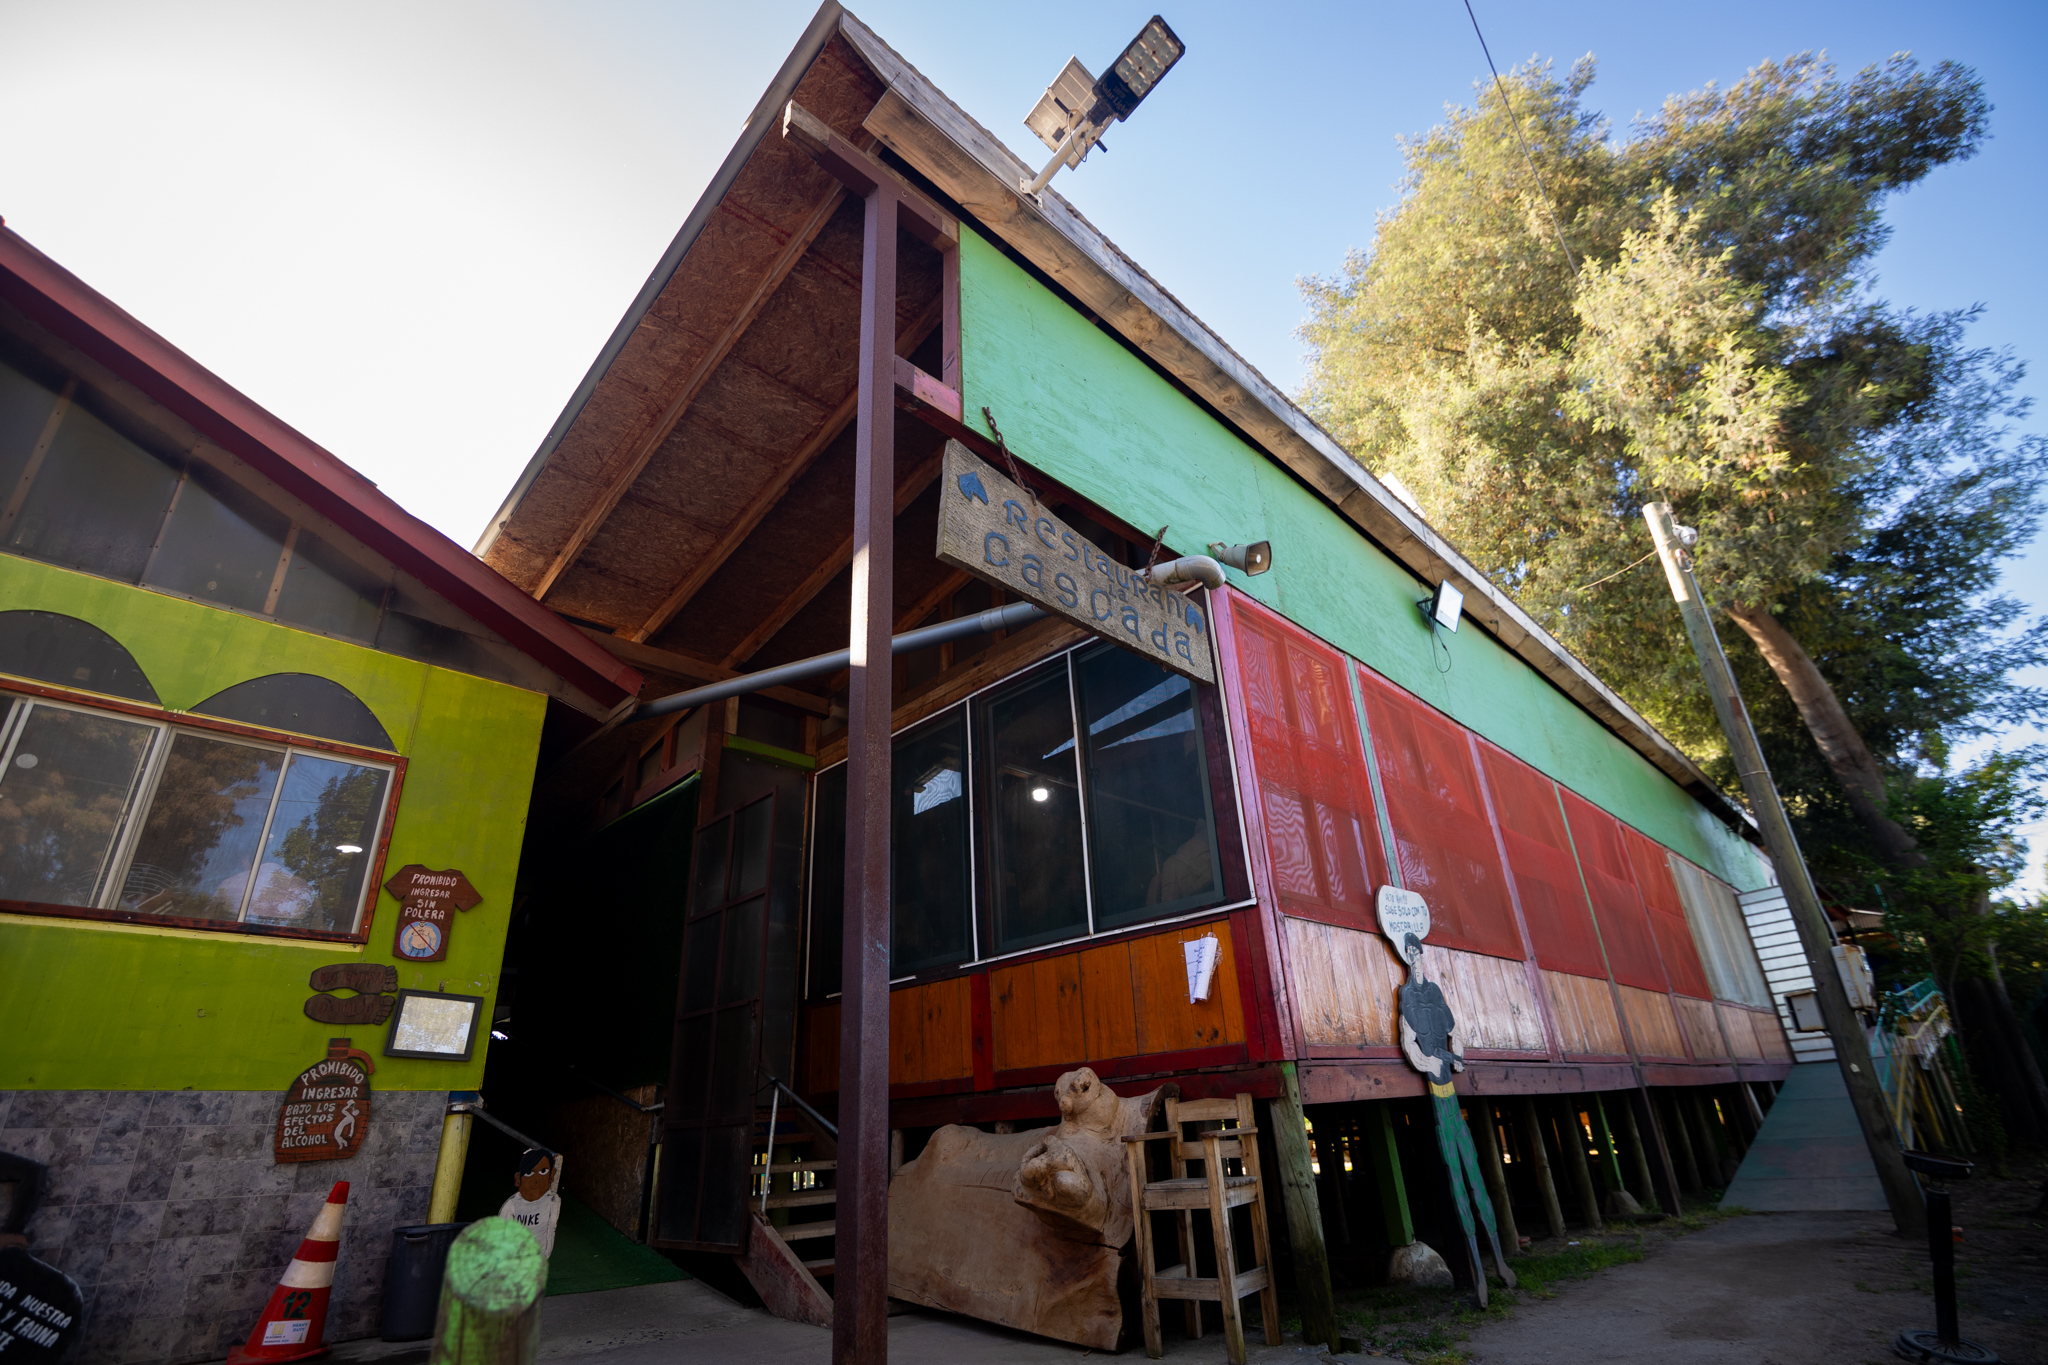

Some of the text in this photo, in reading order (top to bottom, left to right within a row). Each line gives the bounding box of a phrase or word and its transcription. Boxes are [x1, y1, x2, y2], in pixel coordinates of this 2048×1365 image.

[411, 873, 458, 887] PROHIBIDO
[410, 887, 451, 899] INGRESAR
[417, 898, 437, 909] SIN
[404, 906, 446, 920] POLERA
[301, 1061, 365, 1086] PROHIBIDO
[302, 1086, 359, 1100] INGRESAR
[285, 1102, 336, 1117] BAJO LOS
[283, 1113, 335, 1127] EFECTOS
[283, 1125, 305, 1137] DEL
[281, 1133, 328, 1149] ALCOHOL
[517, 1213, 540, 1226] NIKE
[19, 1293, 73, 1329] NUESTRA
[282, 1291, 312, 1319] 12
[12, 1315, 60, 1349] FAUNA
